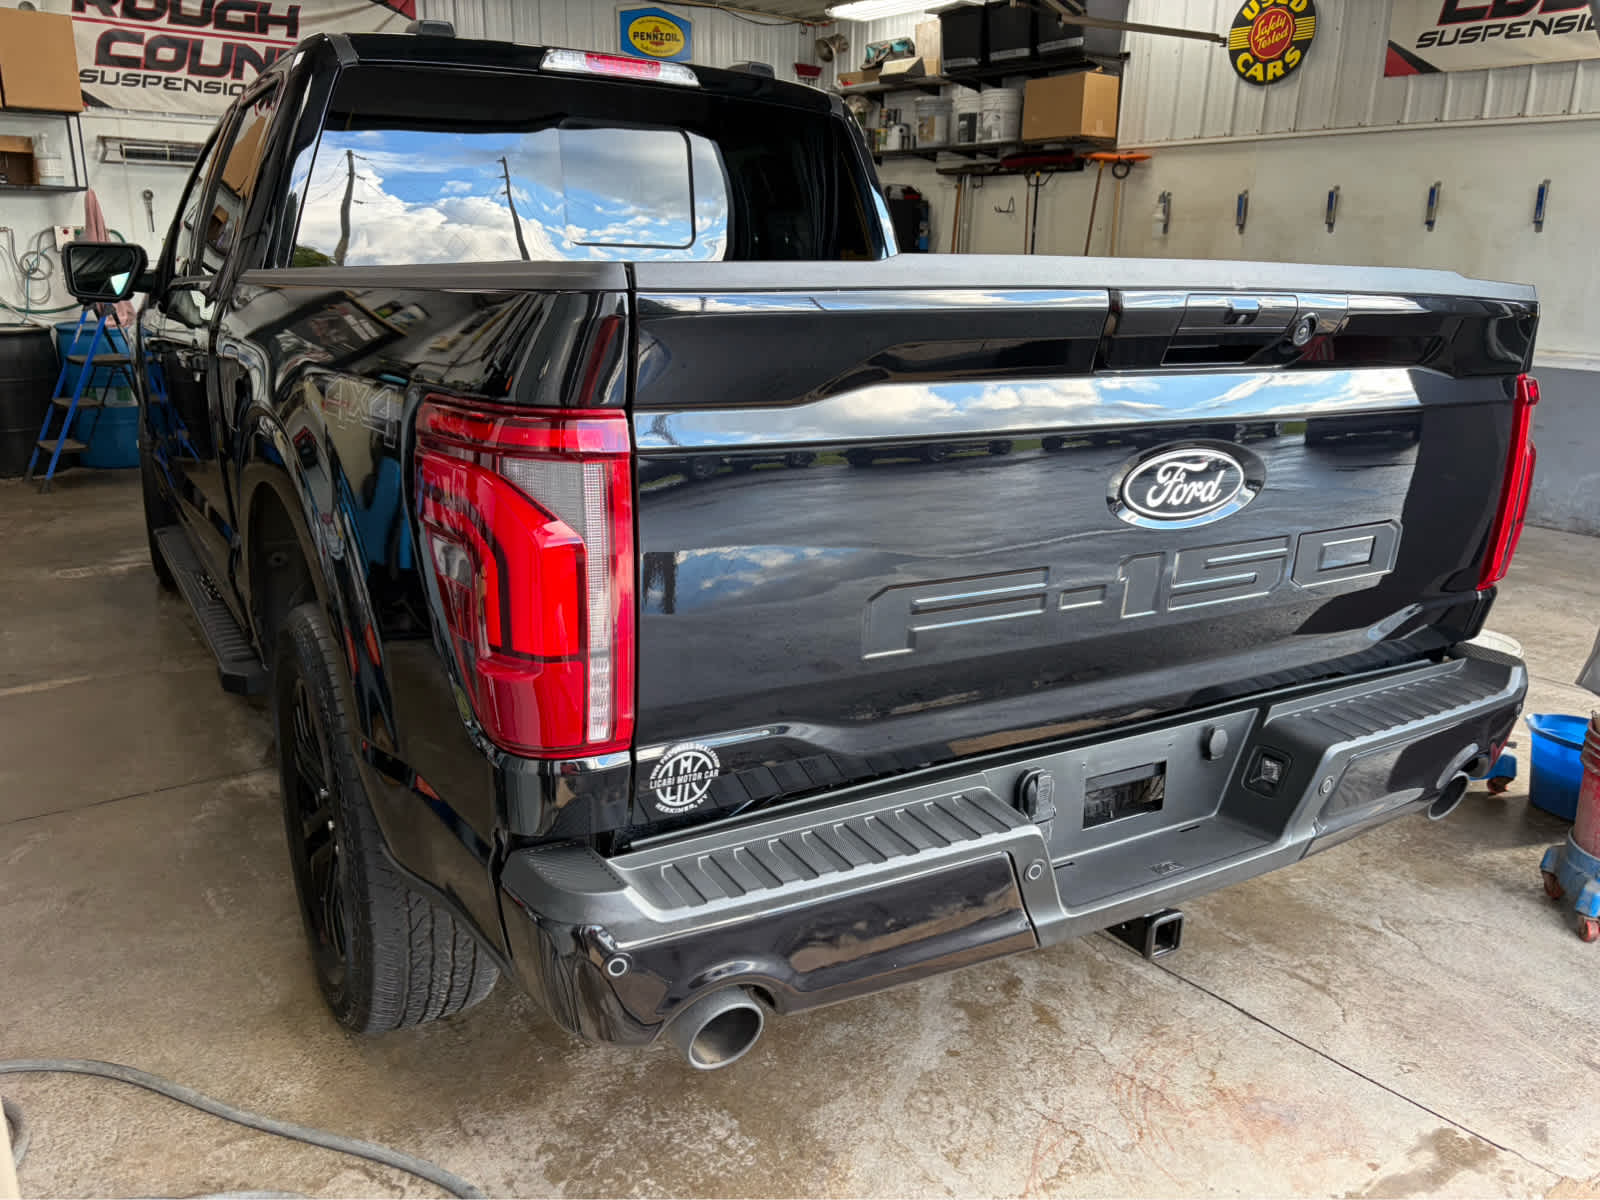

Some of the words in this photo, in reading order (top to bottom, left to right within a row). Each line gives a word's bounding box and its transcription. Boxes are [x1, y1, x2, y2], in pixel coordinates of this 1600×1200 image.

[1242, 0, 1307, 20] UD
[633, 31, 681, 42] PENNZOIL
[1255, 15, 1287, 41] Safety
[1256, 24, 1289, 51] Tested
[1416, 14, 1595, 48] SUSPENSI
[95, 28, 290, 80] COUN
[1236, 46, 1302, 81] CARS
[79, 69, 247, 97] SUSPENSIO
[1145, 459, 1225, 508] Ford
[861, 519, 1403, 660] F-150
[677, 772, 703, 784] MOTOR
[704, 768, 720, 779] CAR
[697, 794, 708, 804] NY
